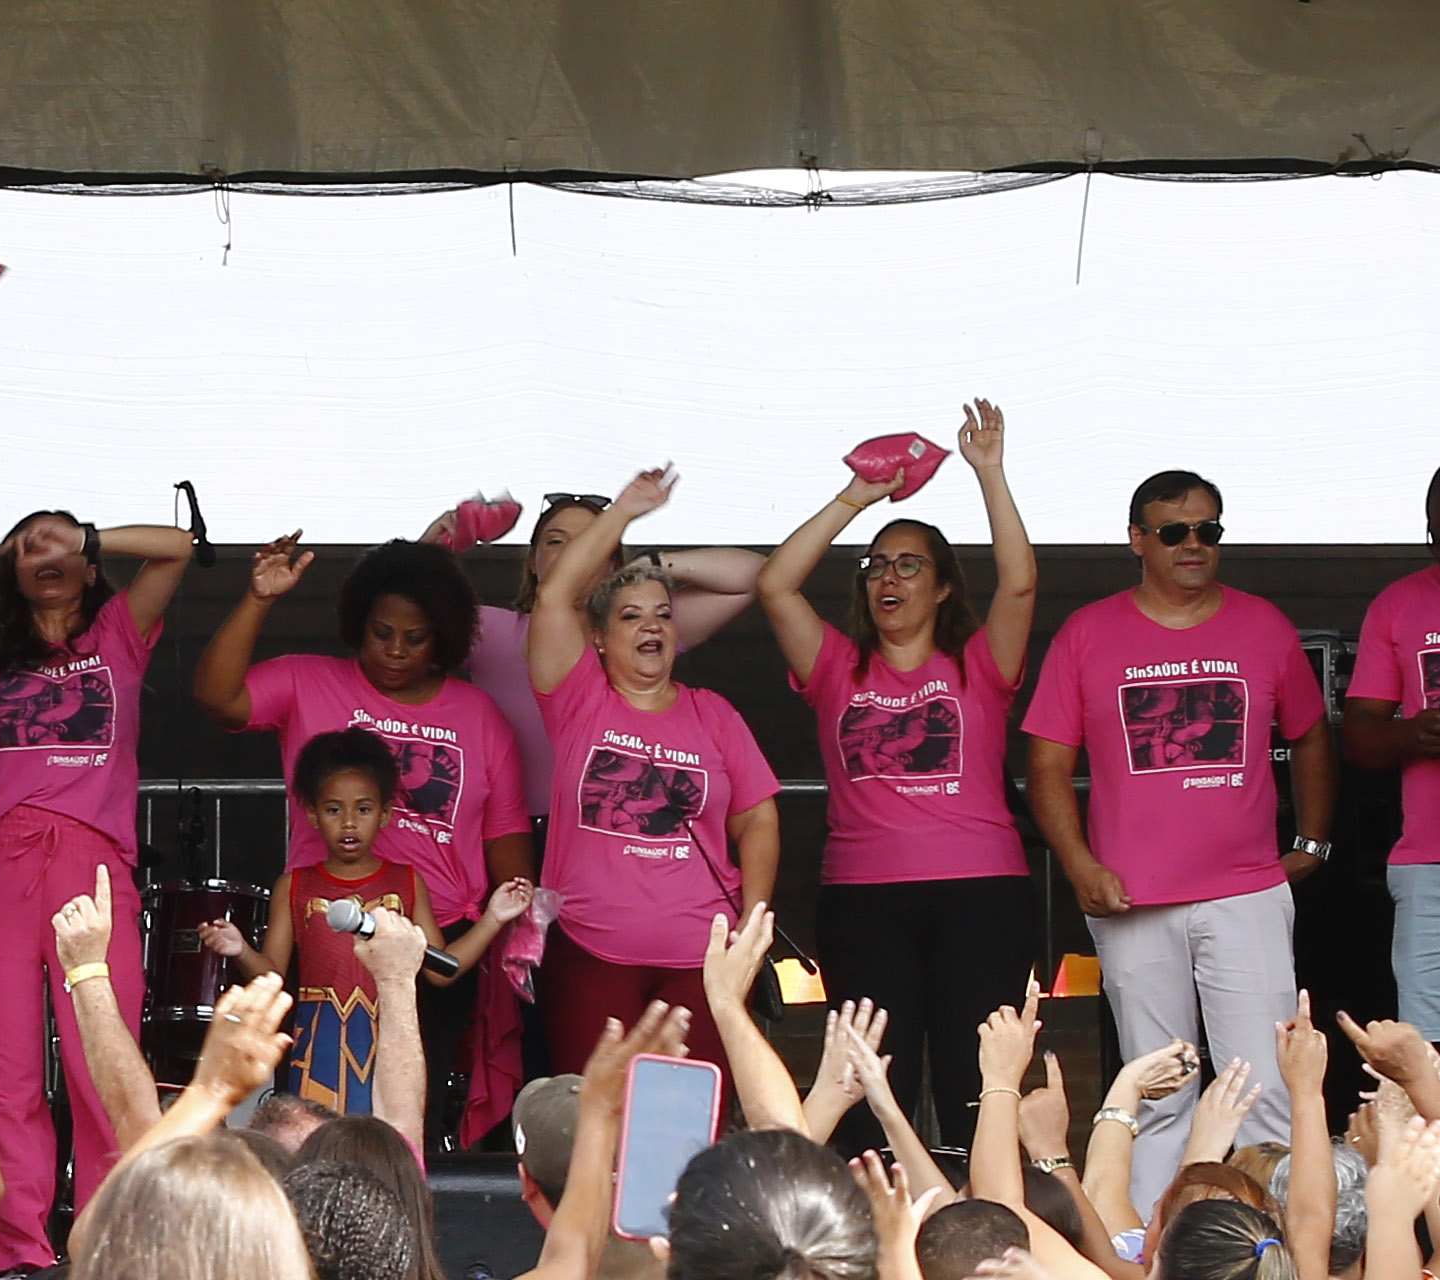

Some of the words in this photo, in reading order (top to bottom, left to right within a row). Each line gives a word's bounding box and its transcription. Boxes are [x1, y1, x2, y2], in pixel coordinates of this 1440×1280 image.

[1124, 661, 1189, 681] SinSAÚDE
[1190, 659, 1200, 675] É
[1201, 659, 1240, 675] VIDA!
[420, 725, 457, 743] VIDA!
[663, 748, 701, 766] VIDA!
